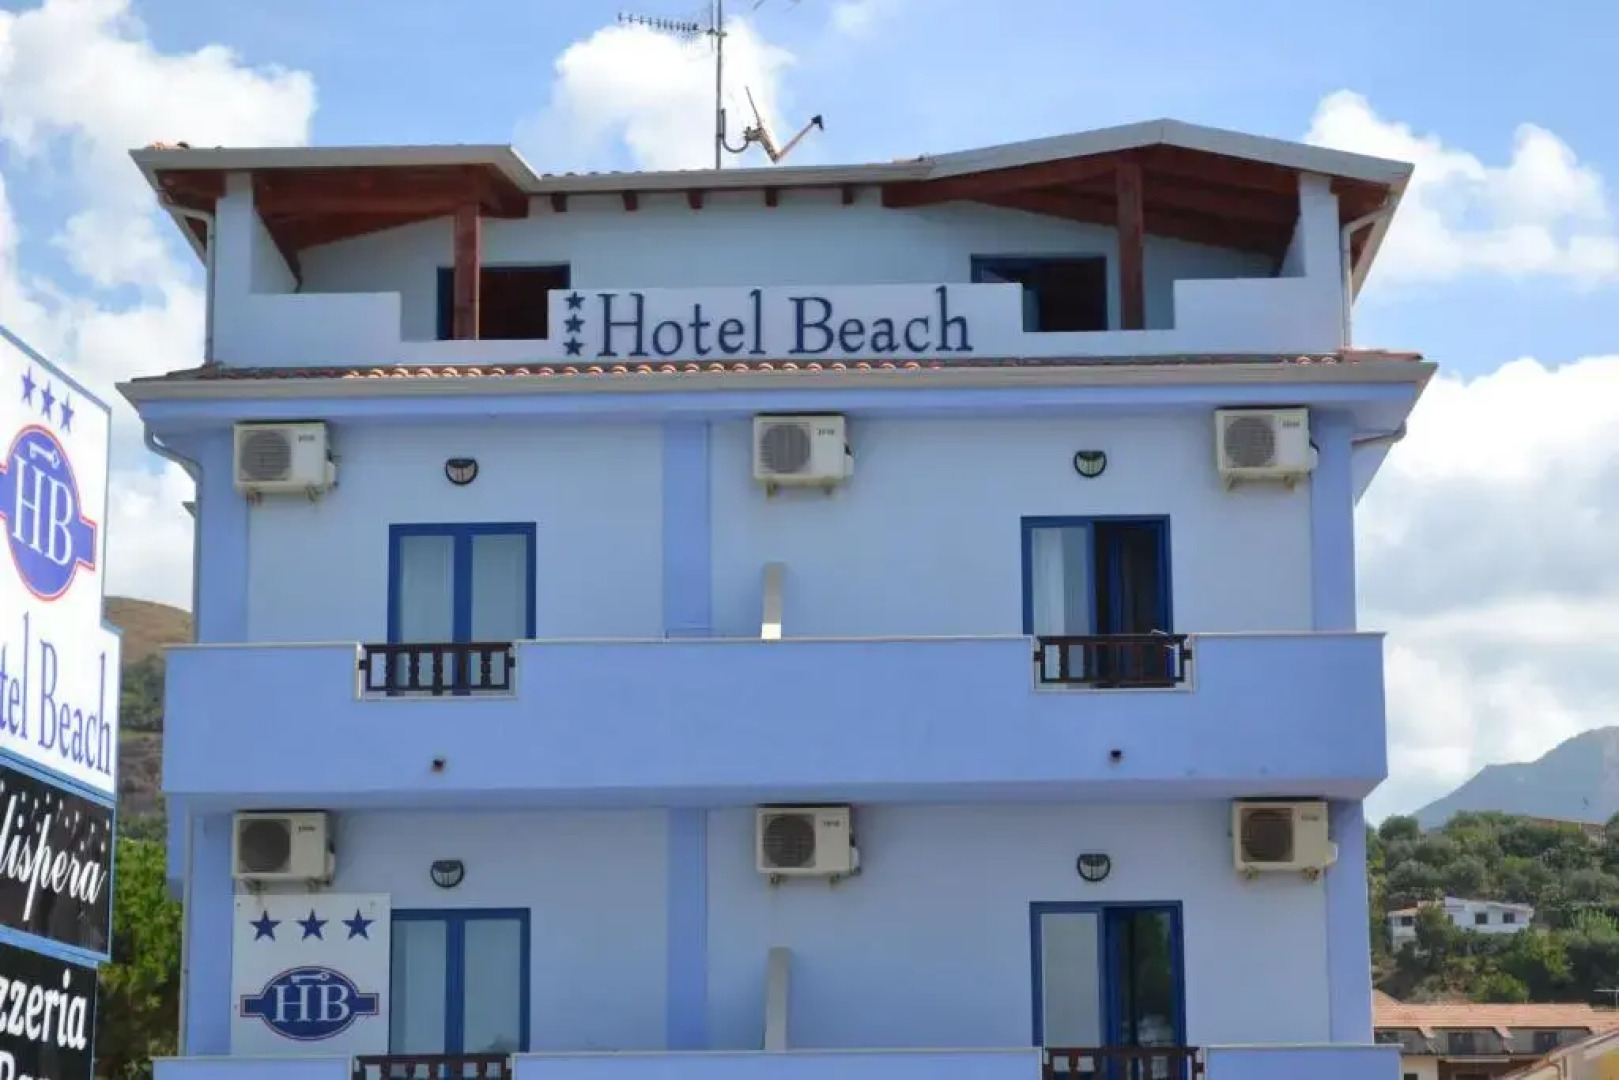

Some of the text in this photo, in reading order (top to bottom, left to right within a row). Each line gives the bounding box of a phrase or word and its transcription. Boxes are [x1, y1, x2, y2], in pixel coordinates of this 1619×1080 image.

[596, 285, 974, 357] Hotel Beach
[12, 454, 73, 566] HB
[38, 638, 111, 775] Beach
[272, 984, 350, 1022] HB
